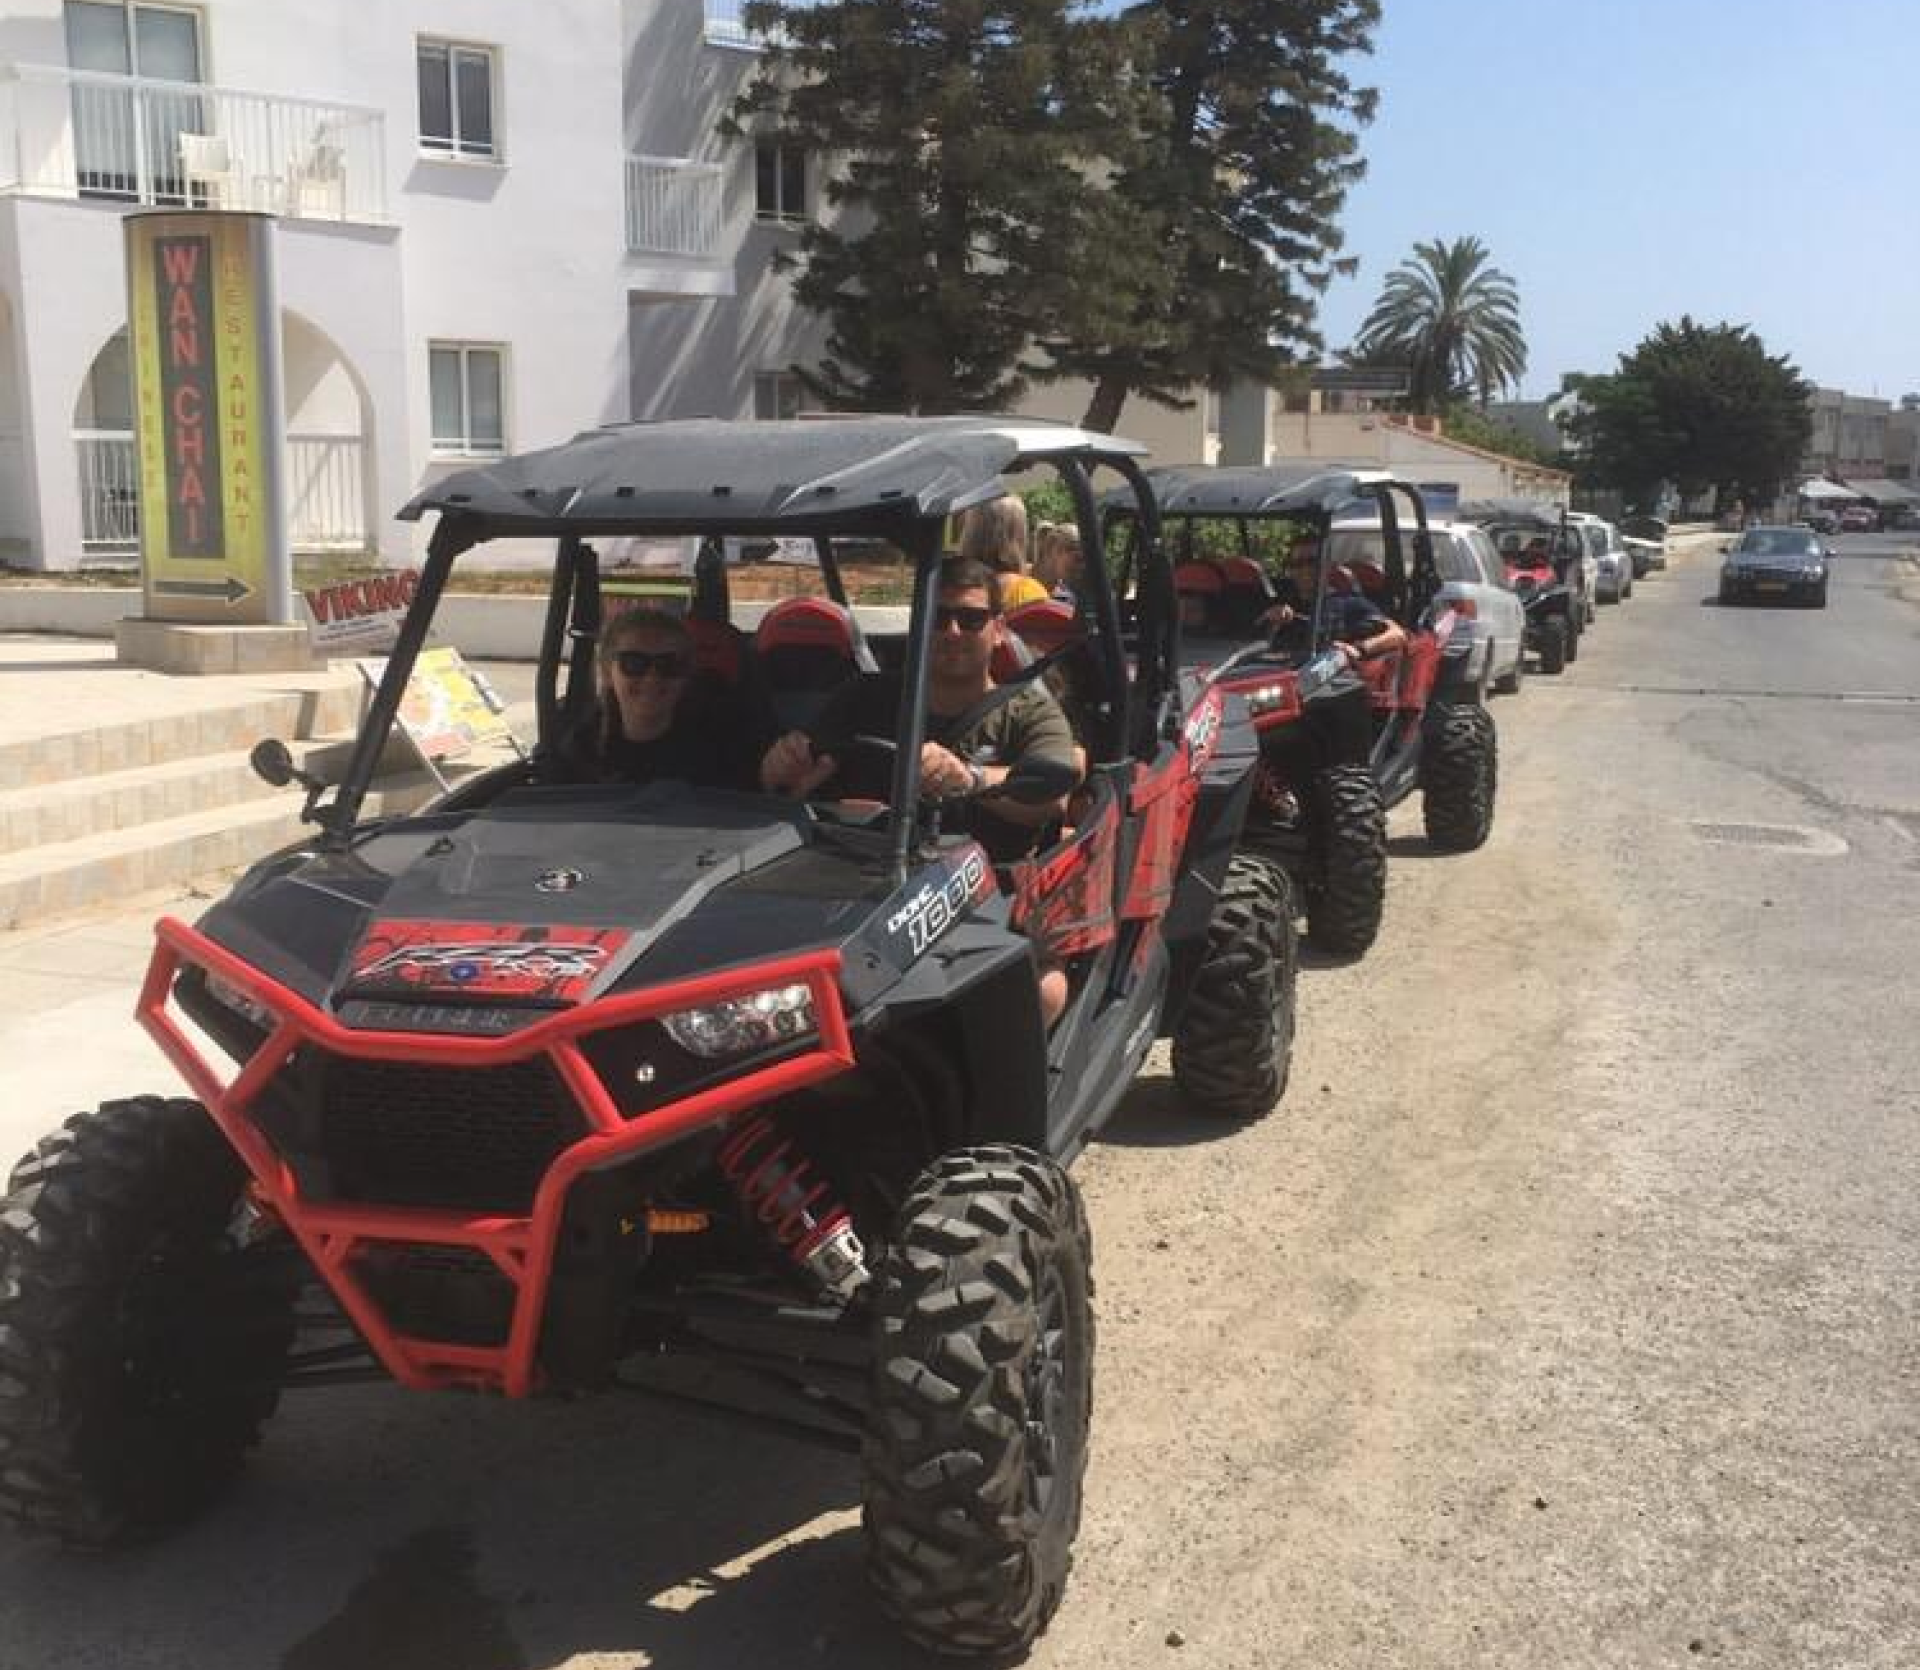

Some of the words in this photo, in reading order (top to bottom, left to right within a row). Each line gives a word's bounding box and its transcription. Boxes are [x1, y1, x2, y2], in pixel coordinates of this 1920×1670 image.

[162, 244, 201, 367] WAN
[173, 384, 206, 542] CHAI
[223, 252, 250, 532] RESTAURANT
